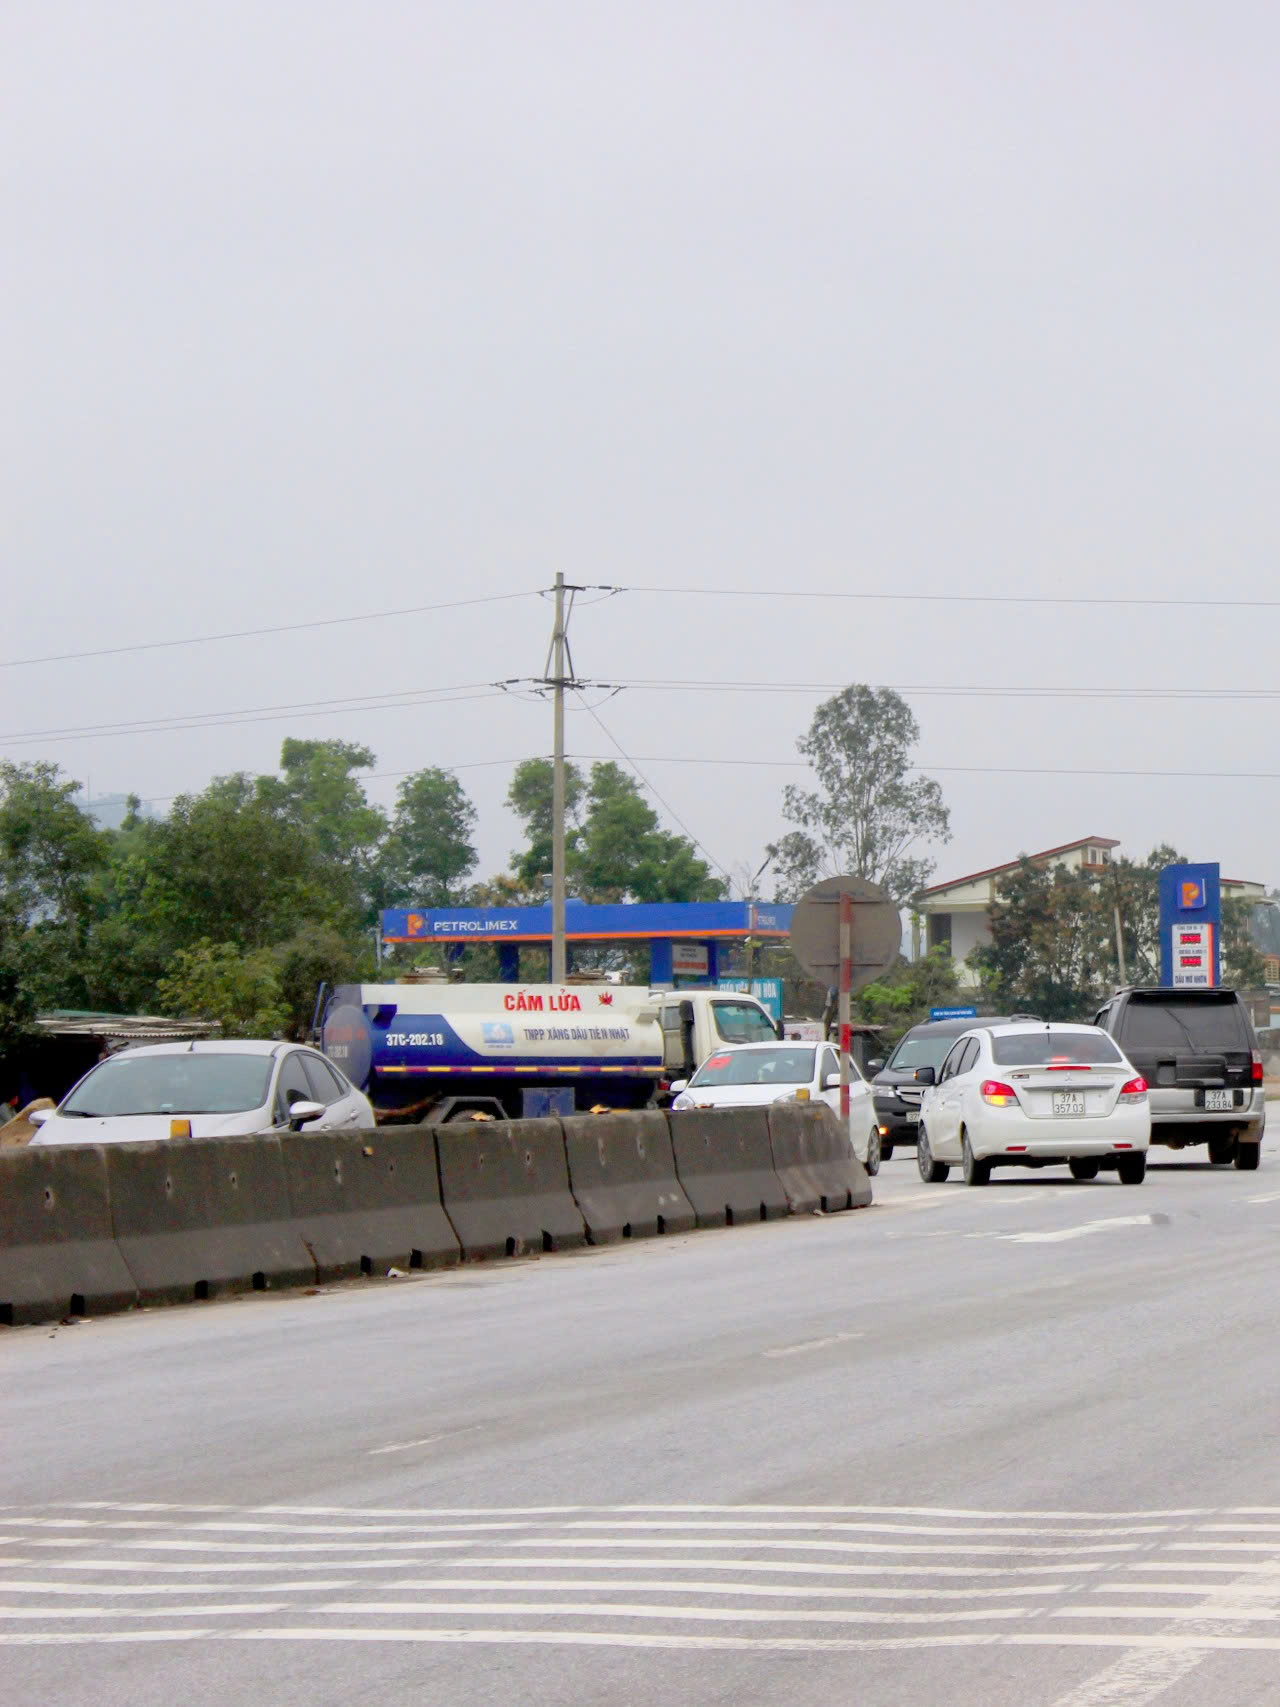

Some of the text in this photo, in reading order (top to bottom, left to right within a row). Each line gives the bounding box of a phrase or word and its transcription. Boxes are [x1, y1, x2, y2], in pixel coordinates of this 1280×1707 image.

[433, 920, 518, 932] PETROLIMEX
[503, 989, 582, 1011] CẤM LỬA
[523, 1028, 545, 1041] TNPP
[1060, 1093, 1077, 1103] 37A
